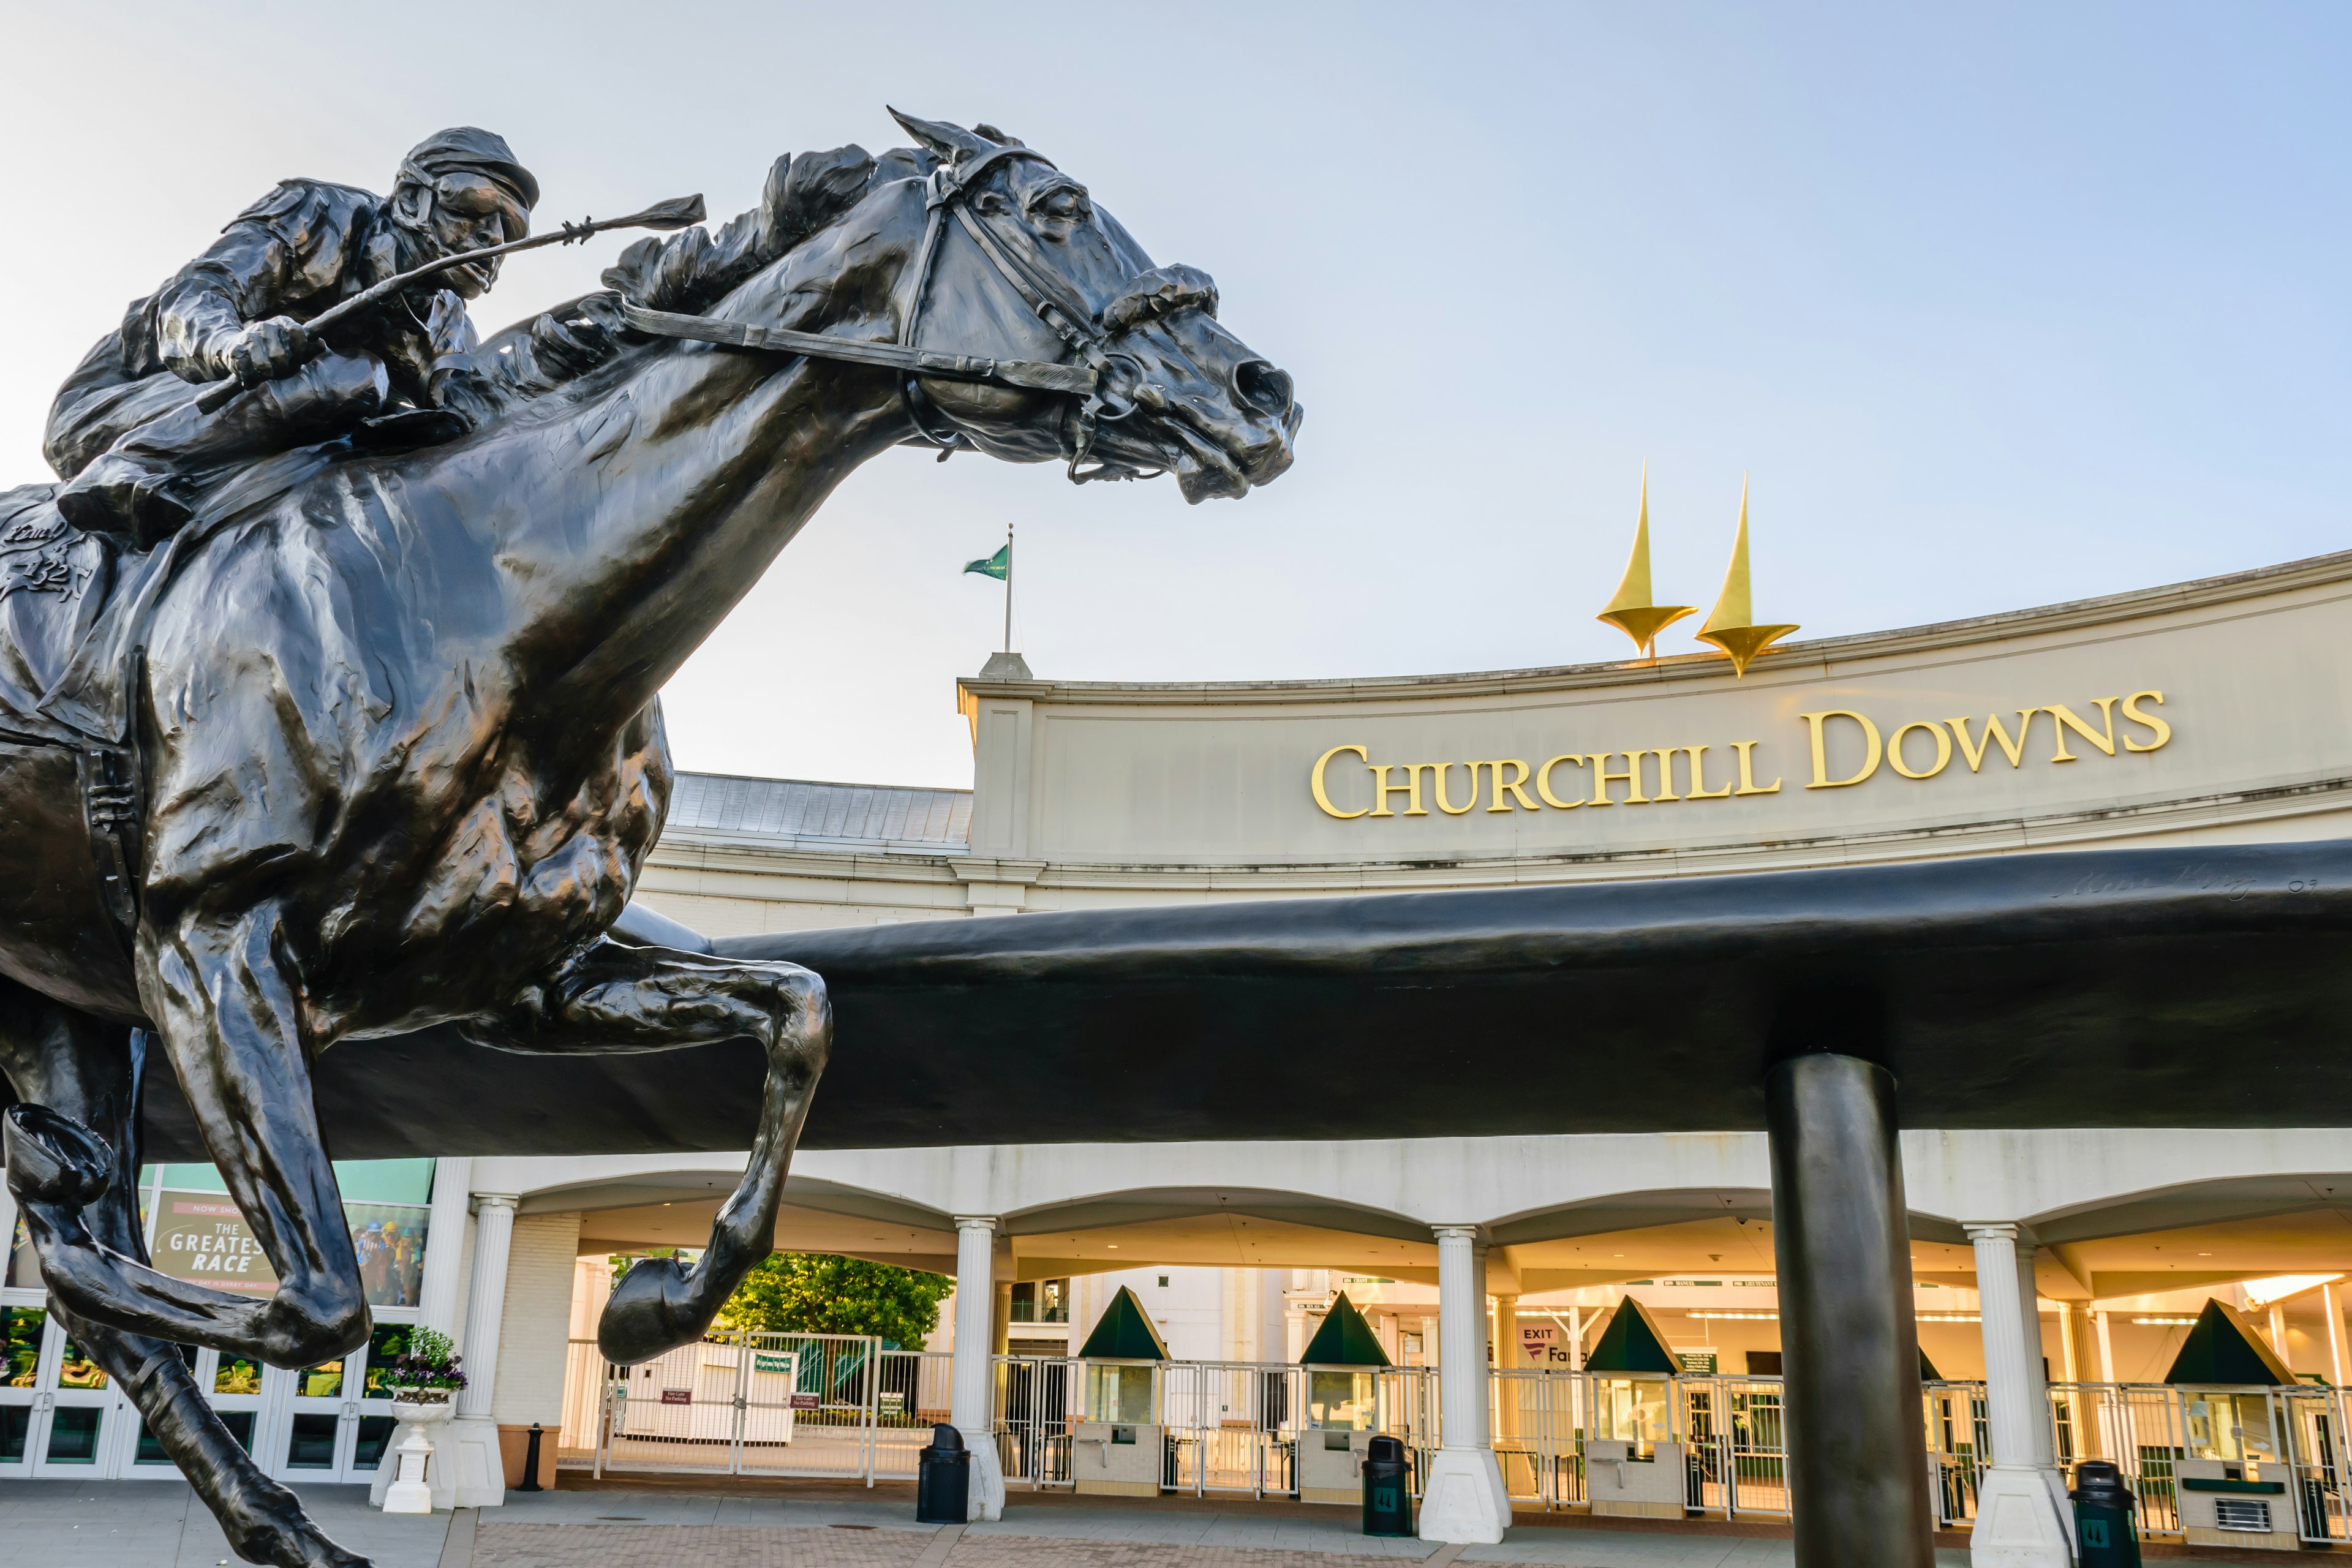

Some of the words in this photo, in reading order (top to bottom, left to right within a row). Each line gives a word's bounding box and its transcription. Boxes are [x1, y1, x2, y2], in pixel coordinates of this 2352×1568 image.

[1311, 740, 1781, 818] CHURCHILL
[1800, 690, 2171, 790] DOWNS
[215, 1223, 239, 1235] THE
[170, 1233, 264, 1255] GREATES
[191, 1253, 252, 1273] RACE
[1524, 1329, 1553, 1339] EXIT
